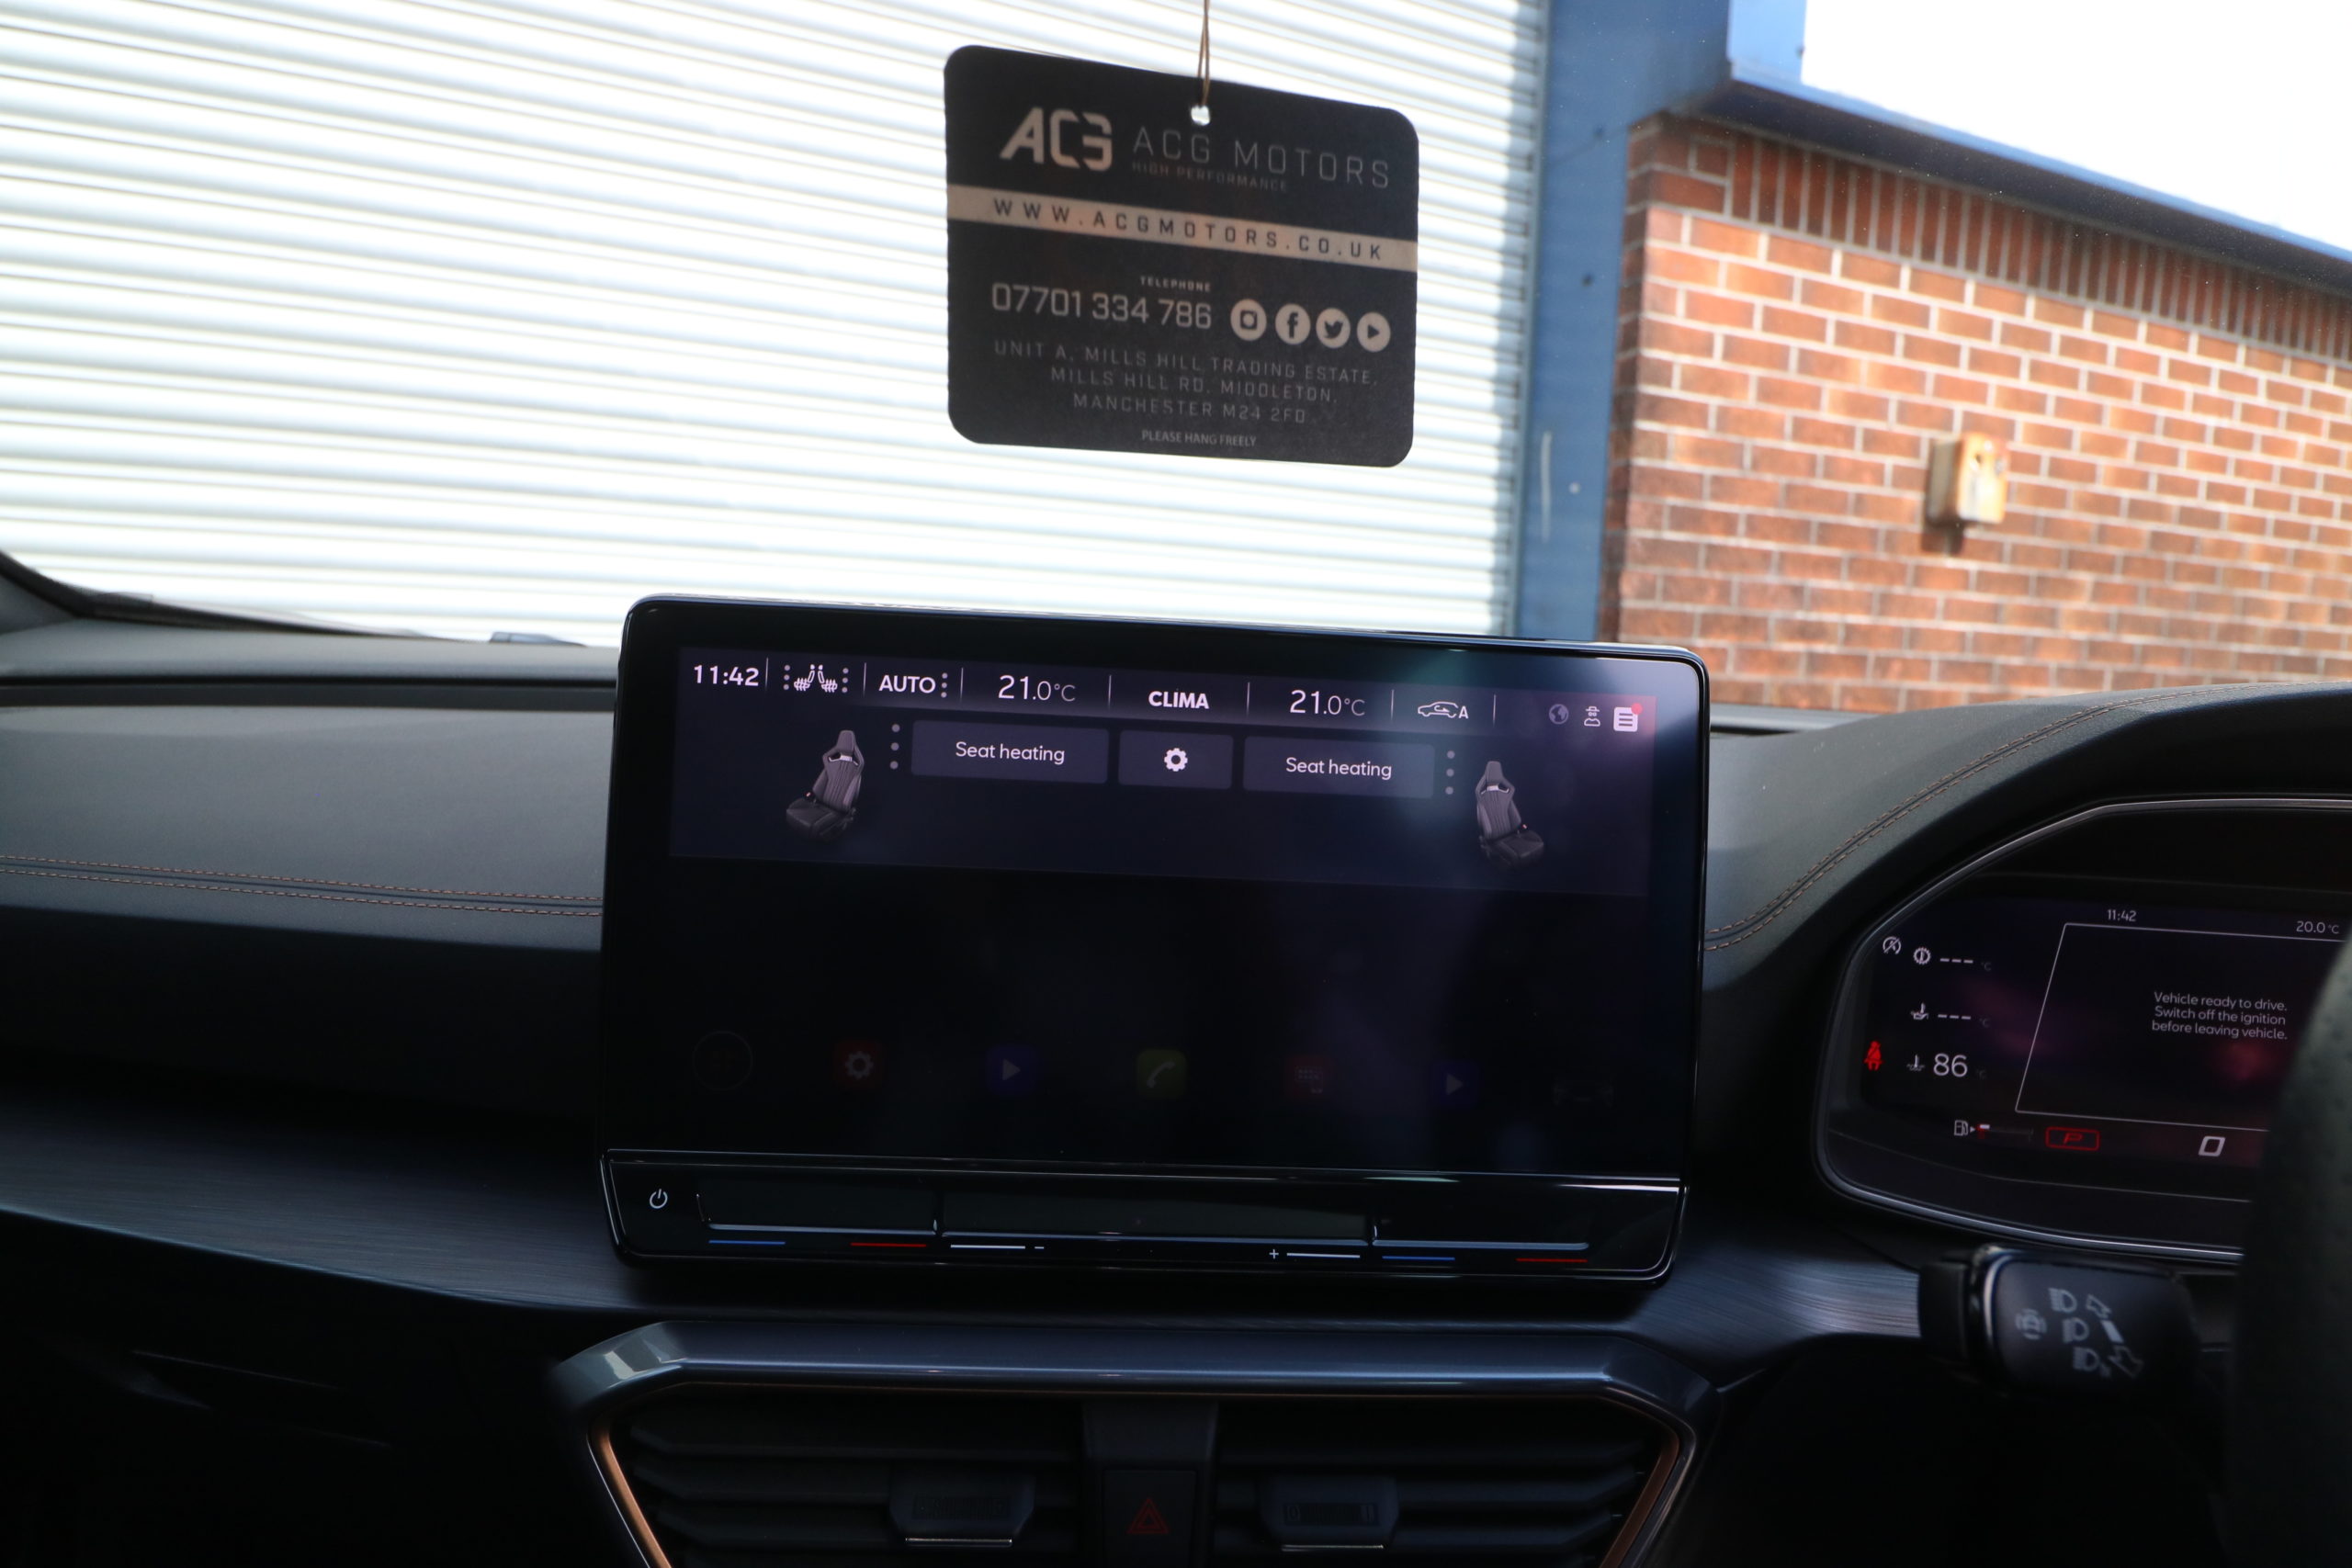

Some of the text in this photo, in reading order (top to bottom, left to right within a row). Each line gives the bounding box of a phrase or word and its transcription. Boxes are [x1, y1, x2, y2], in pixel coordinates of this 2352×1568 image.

[1133, 126, 1388, 188] ACG MOTORS
[1132, 161, 1286, 191] HIGH PERFORMANCE
[993, 197, 1382, 260] WWW.ACGMOTORS.CO.UK
[1140, 276, 1211, 293] TELEPHONE
[992, 282, 1212, 329] 07701 334 786
[994, 340, 1045, 358] UNIT
[1085, 345, 1147, 367] MILLS
[1157, 353, 1201, 371] HILL
[1211, 356, 1295, 378] TRADING
[1051, 367, 1114, 387] MILLS
[1125, 372, 1169, 389] HILL
[1073, 392, 1212, 417] MANCHESTER
[1223, 404, 1261, 420] M24
[1142, 429, 1257, 447] PLEASE HANG FREELY
[694, 664, 759, 687] 11:42
[878, 674, 936, 694] AUTO
[1148, 690, 1210, 710] CLIMA
[956, 740, 1066, 765] Seat heating
[1285, 756, 1393, 781] Seat heating
[2107, 908, 2137, 922] 11:42
[2154, 991, 2287, 1011] Vehicle ready to drive.
[2154, 1005, 2286, 1026] Switch off the ignition
[2152, 1020, 2288, 1040] before leaving vehicle.
[1933, 1053, 1968, 1077] 86
[2063, 1131, 2084, 1145] P
